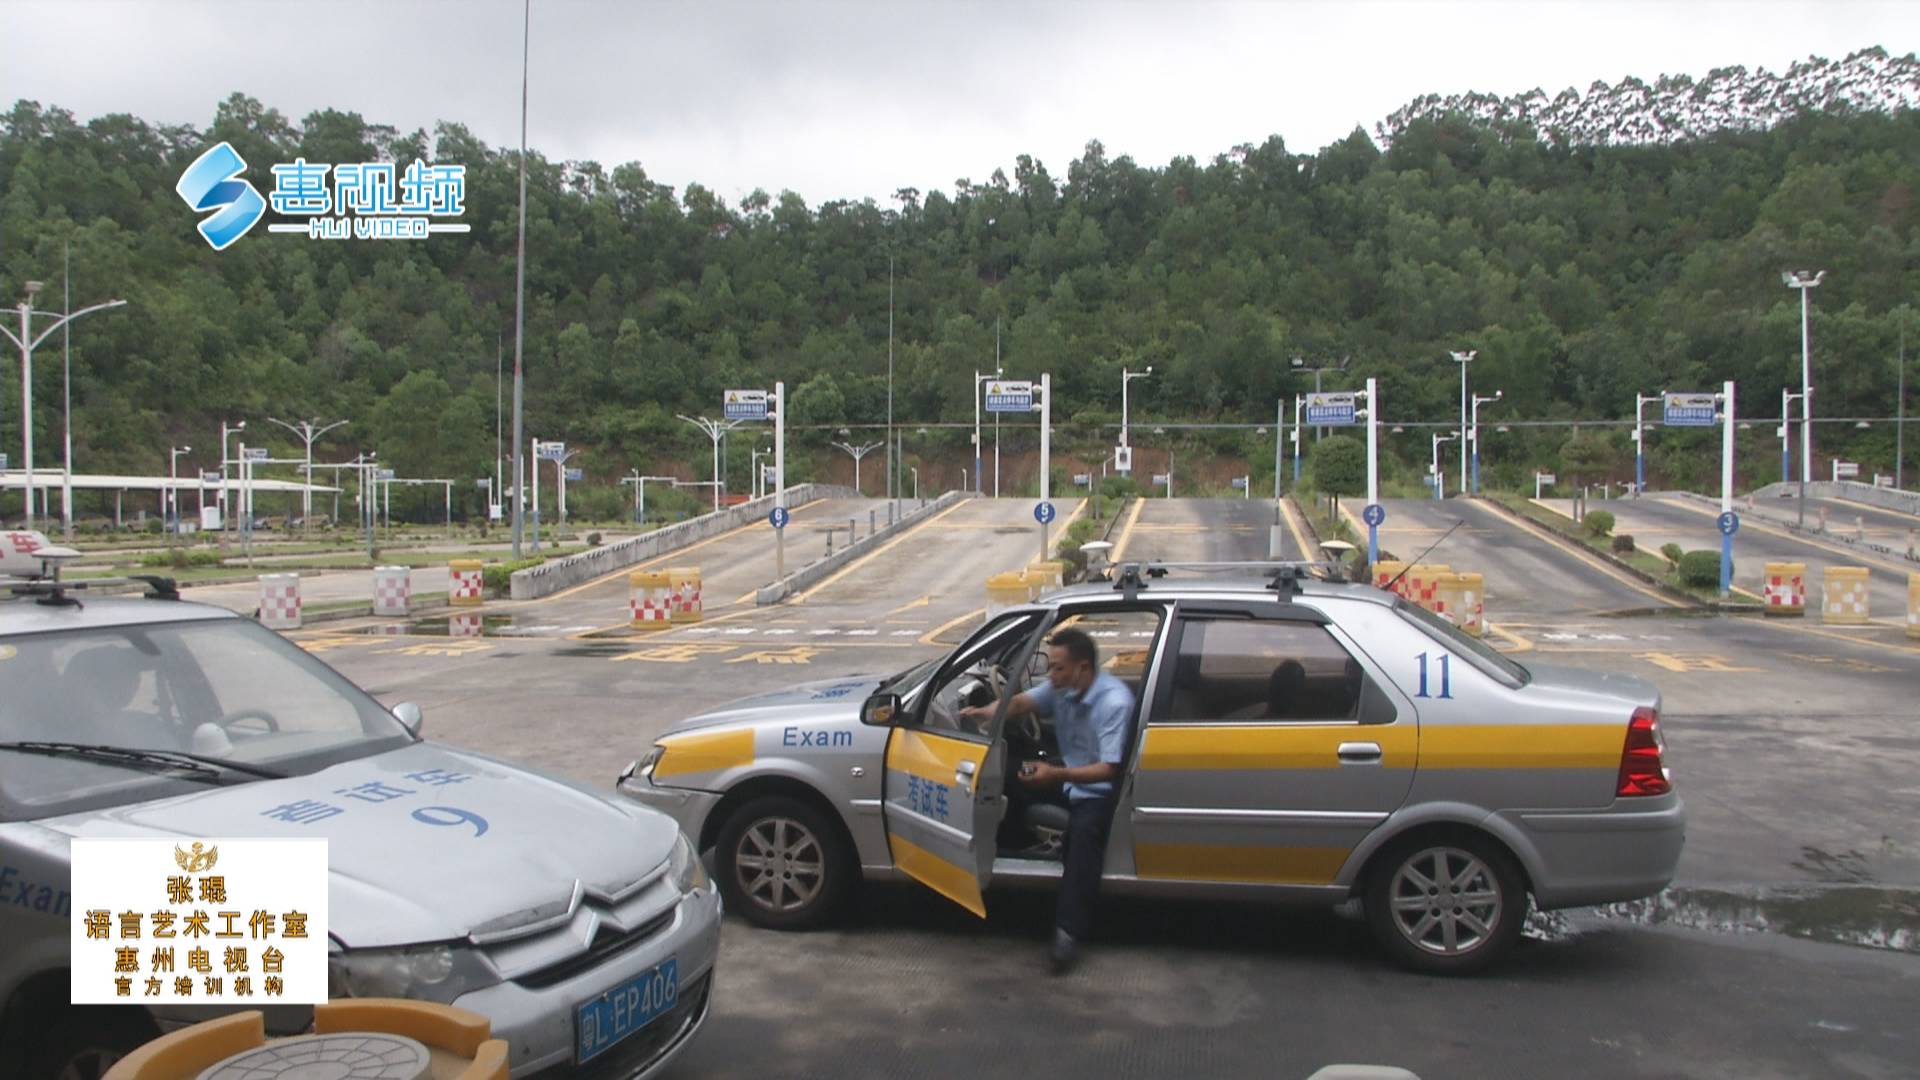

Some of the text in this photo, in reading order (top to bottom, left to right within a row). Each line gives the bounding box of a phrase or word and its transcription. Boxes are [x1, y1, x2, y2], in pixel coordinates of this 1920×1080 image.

[1414, 651, 1454, 699] 11
[783, 726, 852, 746] Exam
[259, 769, 472, 824] 考试车
[411, 806, 489, 837] 9
